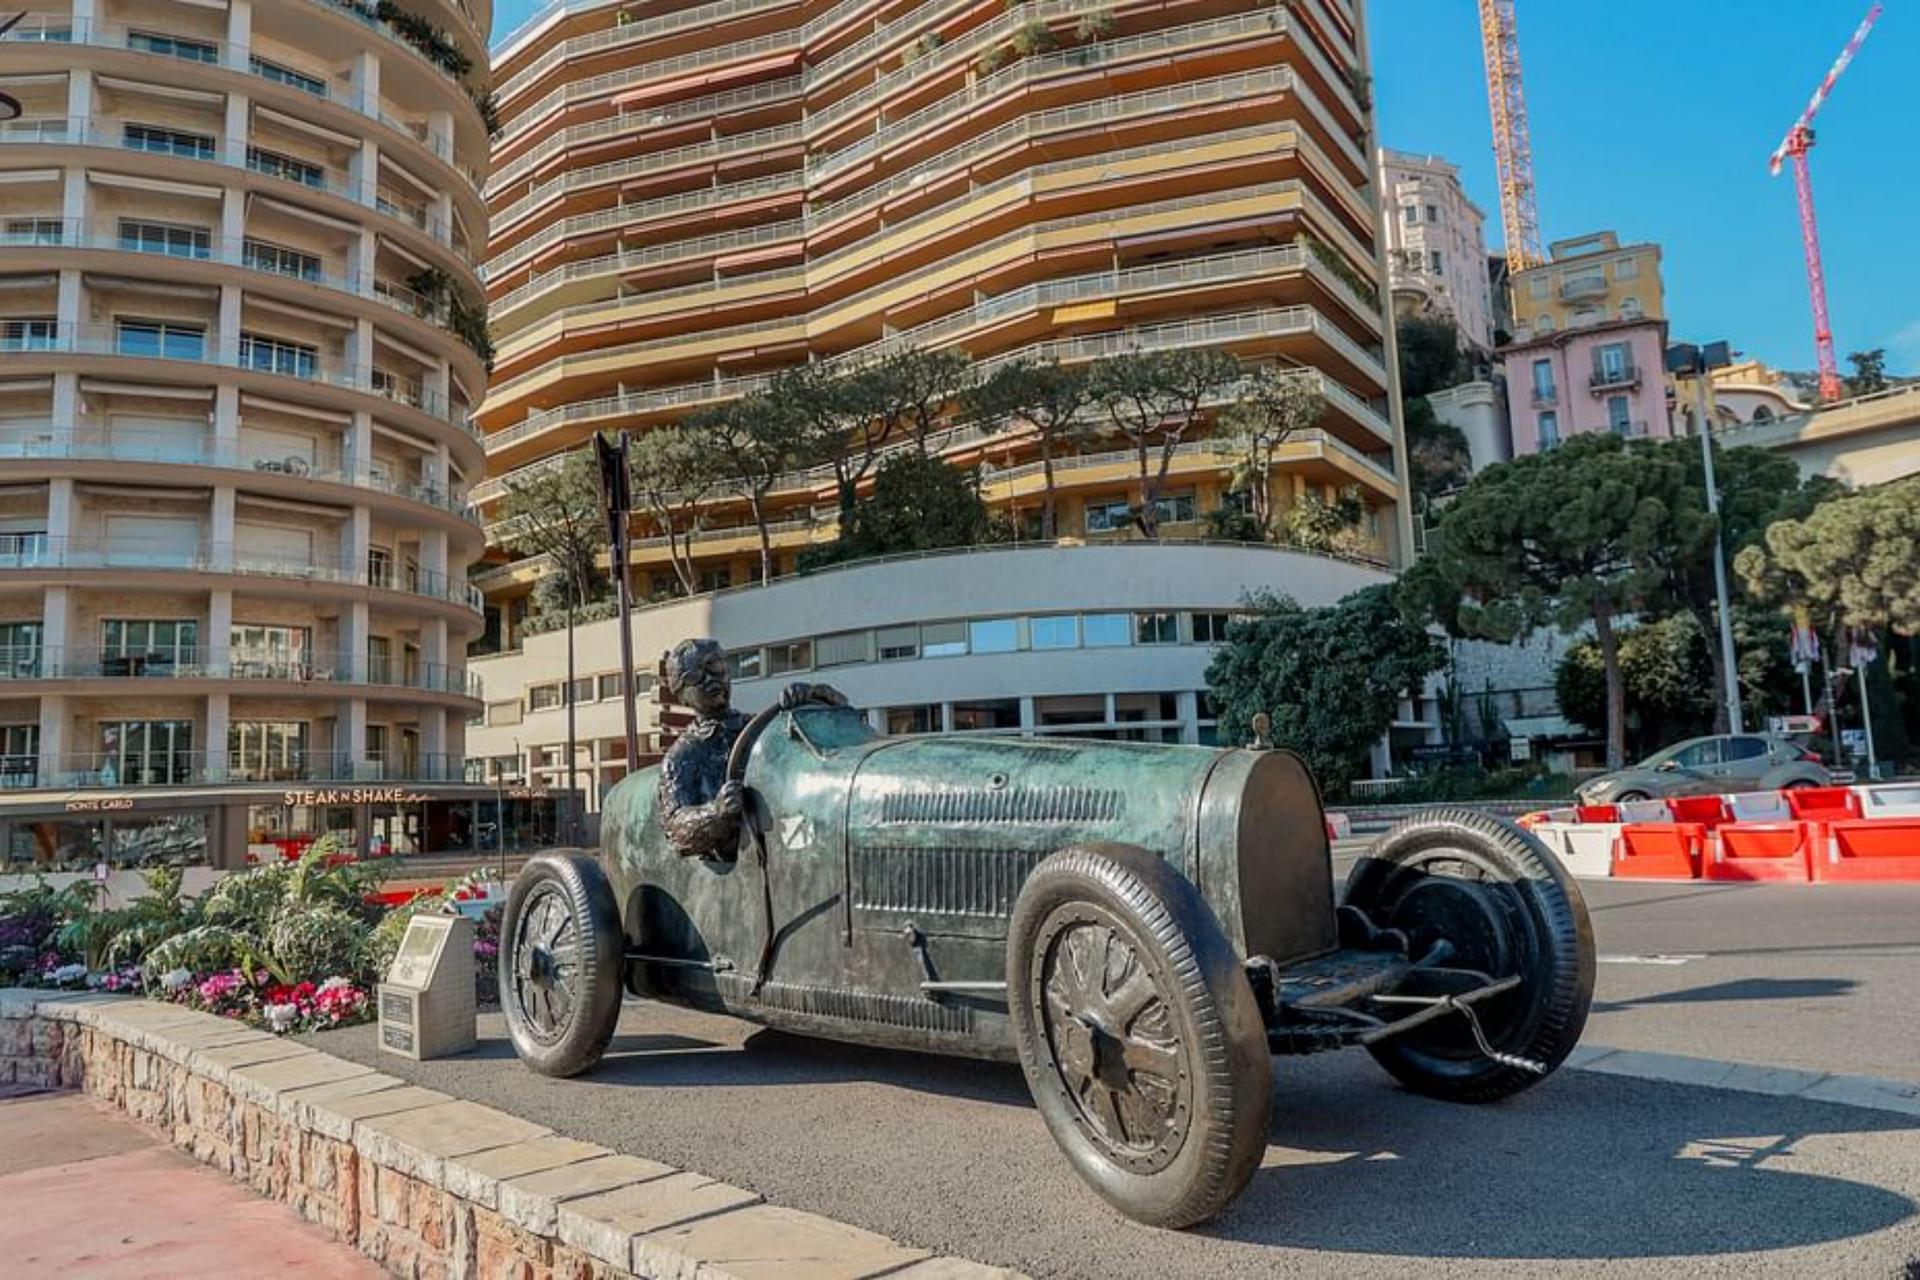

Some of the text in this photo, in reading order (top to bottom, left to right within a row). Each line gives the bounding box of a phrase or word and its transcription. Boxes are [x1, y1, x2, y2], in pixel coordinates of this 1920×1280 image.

[284, 789, 338, 805] STEAK
[353, 788, 403, 803] SHAKE
[65, 800, 133, 811] MONTE CARLO
